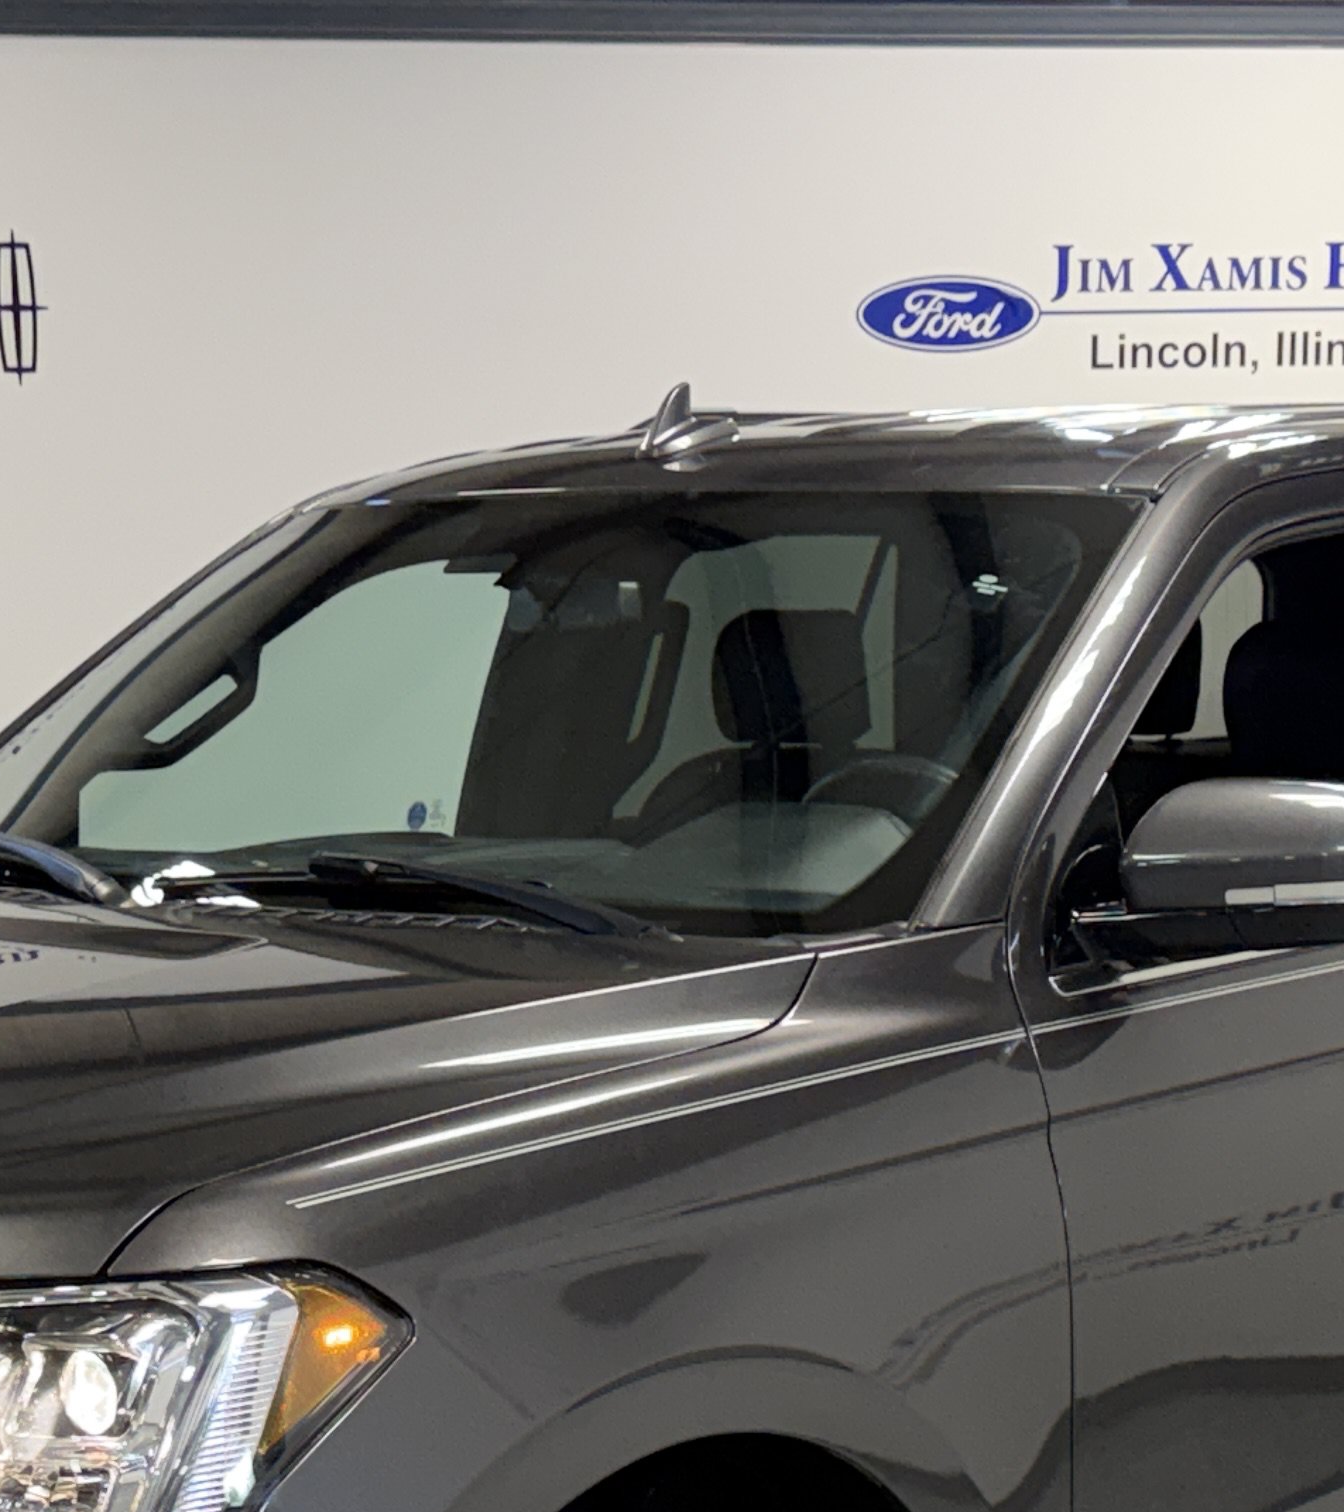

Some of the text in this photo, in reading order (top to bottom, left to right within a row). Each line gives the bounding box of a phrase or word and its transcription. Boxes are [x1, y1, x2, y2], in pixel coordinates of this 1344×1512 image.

[1051, 244, 1133, 302] JIM
[1150, 243, 1308, 293] XAMIS
[892, 288, 1003, 341] Ford
[1090, 332, 1258, 374] Lincoln,
